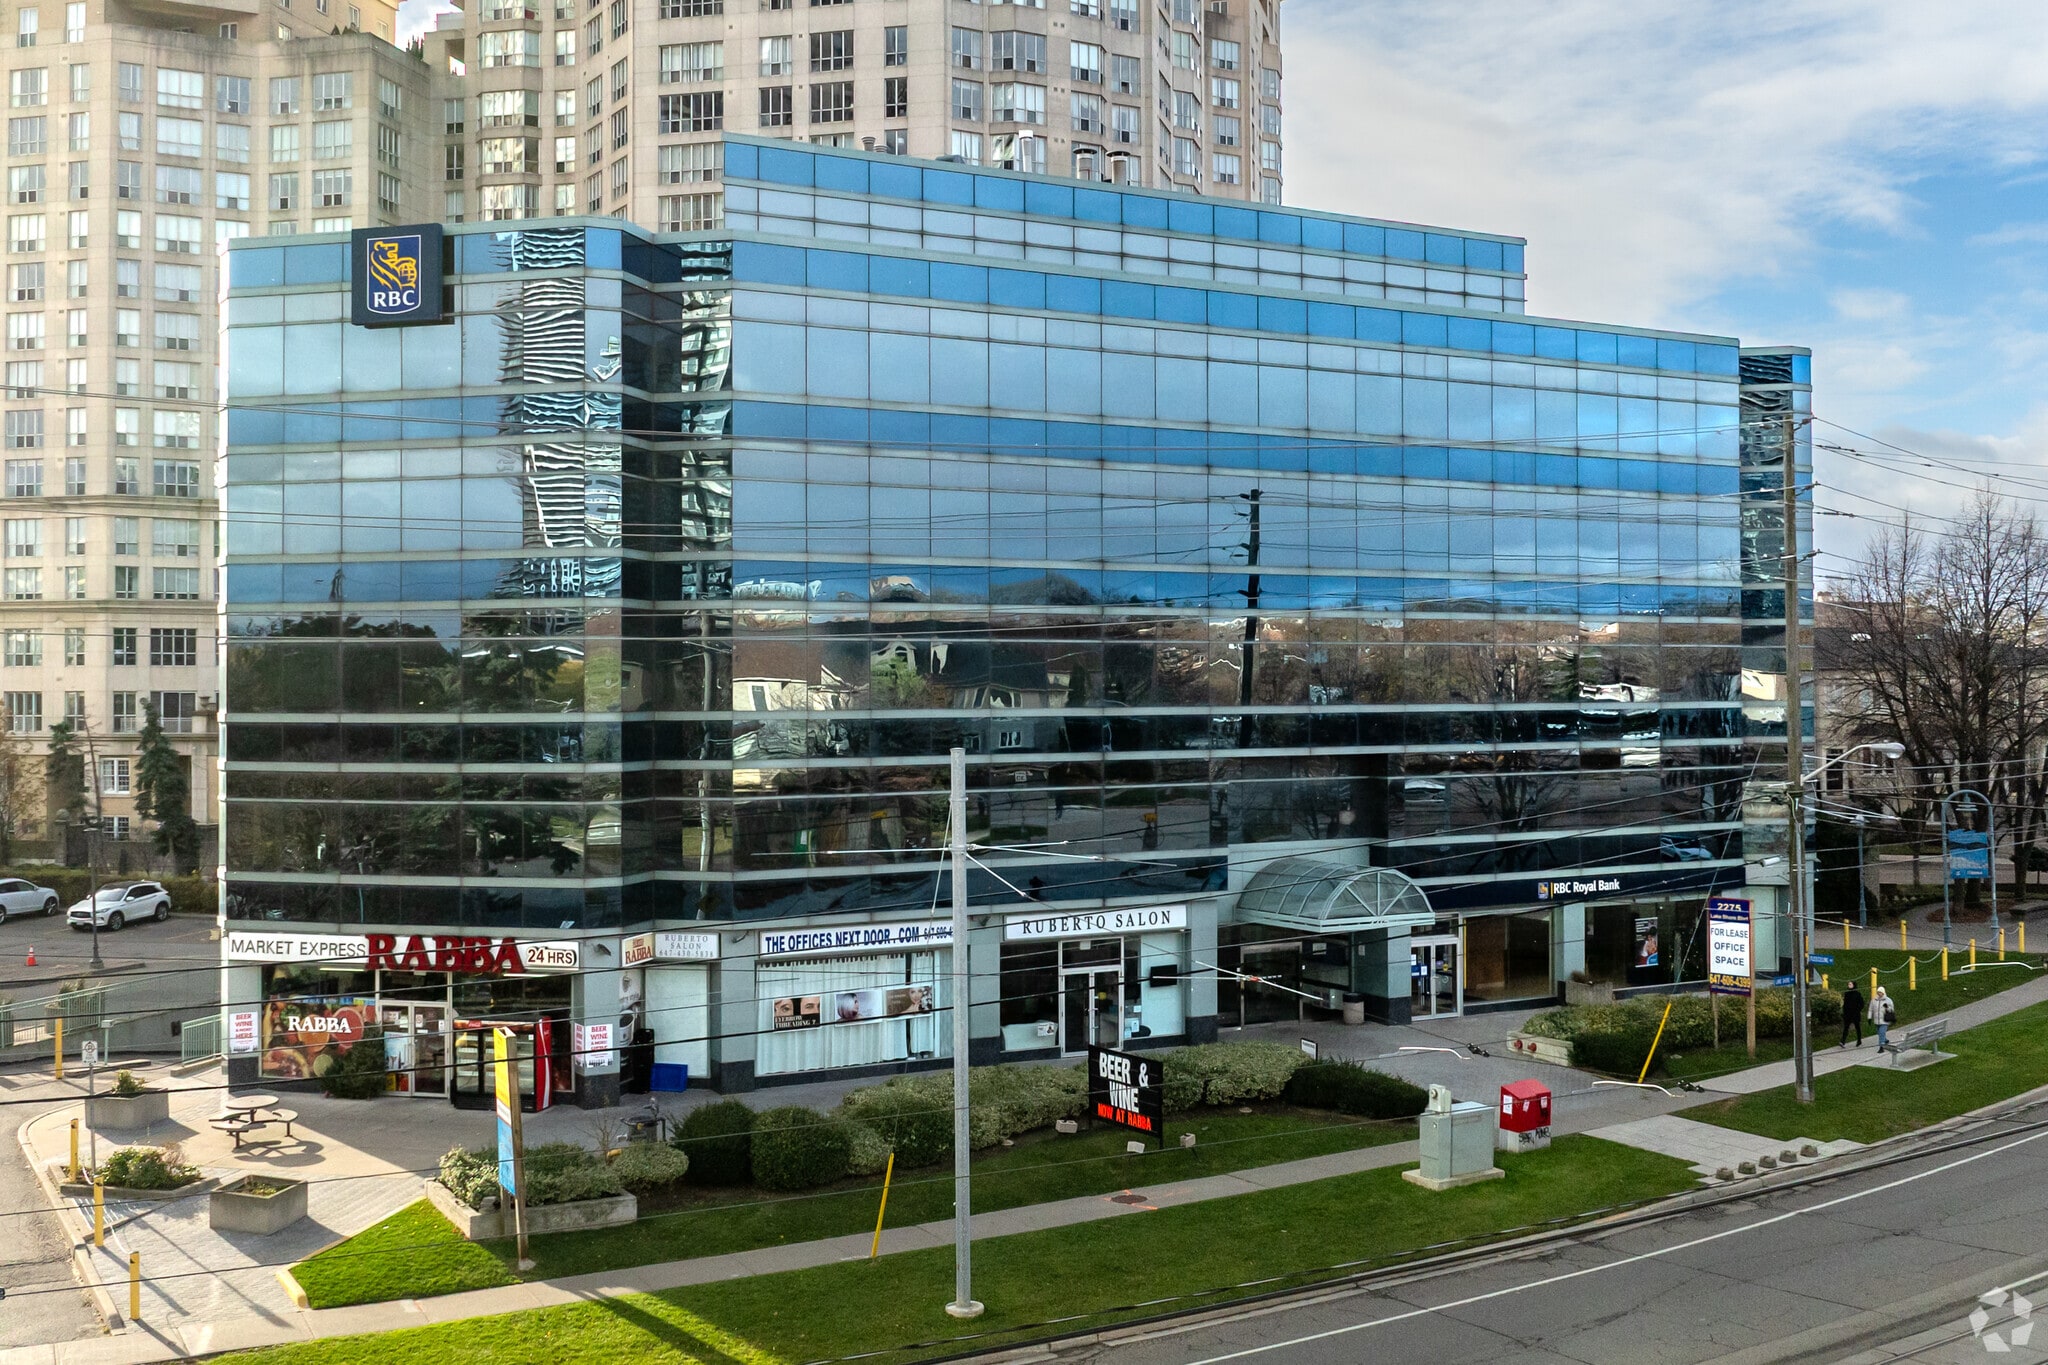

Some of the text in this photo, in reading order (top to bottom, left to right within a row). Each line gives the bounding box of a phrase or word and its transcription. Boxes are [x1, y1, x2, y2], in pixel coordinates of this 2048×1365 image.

[373, 290, 415, 308] RBC
[1554, 879, 1620, 895] RBC Royal Bank
[1717, 903, 1742, 912] 2275
[1022, 910, 1171, 934] RUBERTO SALON
[664, 934, 708, 942] RUBERTO
[765, 935, 785, 953] THE
[788, 932, 833, 950] OFFICES
[836, 929, 861, 947] NEXT
[864, 928, 891, 946] DOOR
[898, 926, 919, 943] COM
[1710, 928, 1748, 939] FOR LEASE
[231, 939, 366, 957] MARKET EXPRESS
[365, 933, 527, 973] RABBA
[625, 945, 652, 965] RABBA
[1714, 941, 1745, 952] OFFICE
[527, 949, 573, 964] 24 HRS
[1715, 955, 1745, 966] SPACE
[287, 1016, 352, 1033] RABBA
[1099, 1051, 1149, 1088] BEER &
[1109, 1081, 1140, 1113] WINE
[1097, 1103, 1152, 1131] NOW AT RABBA
